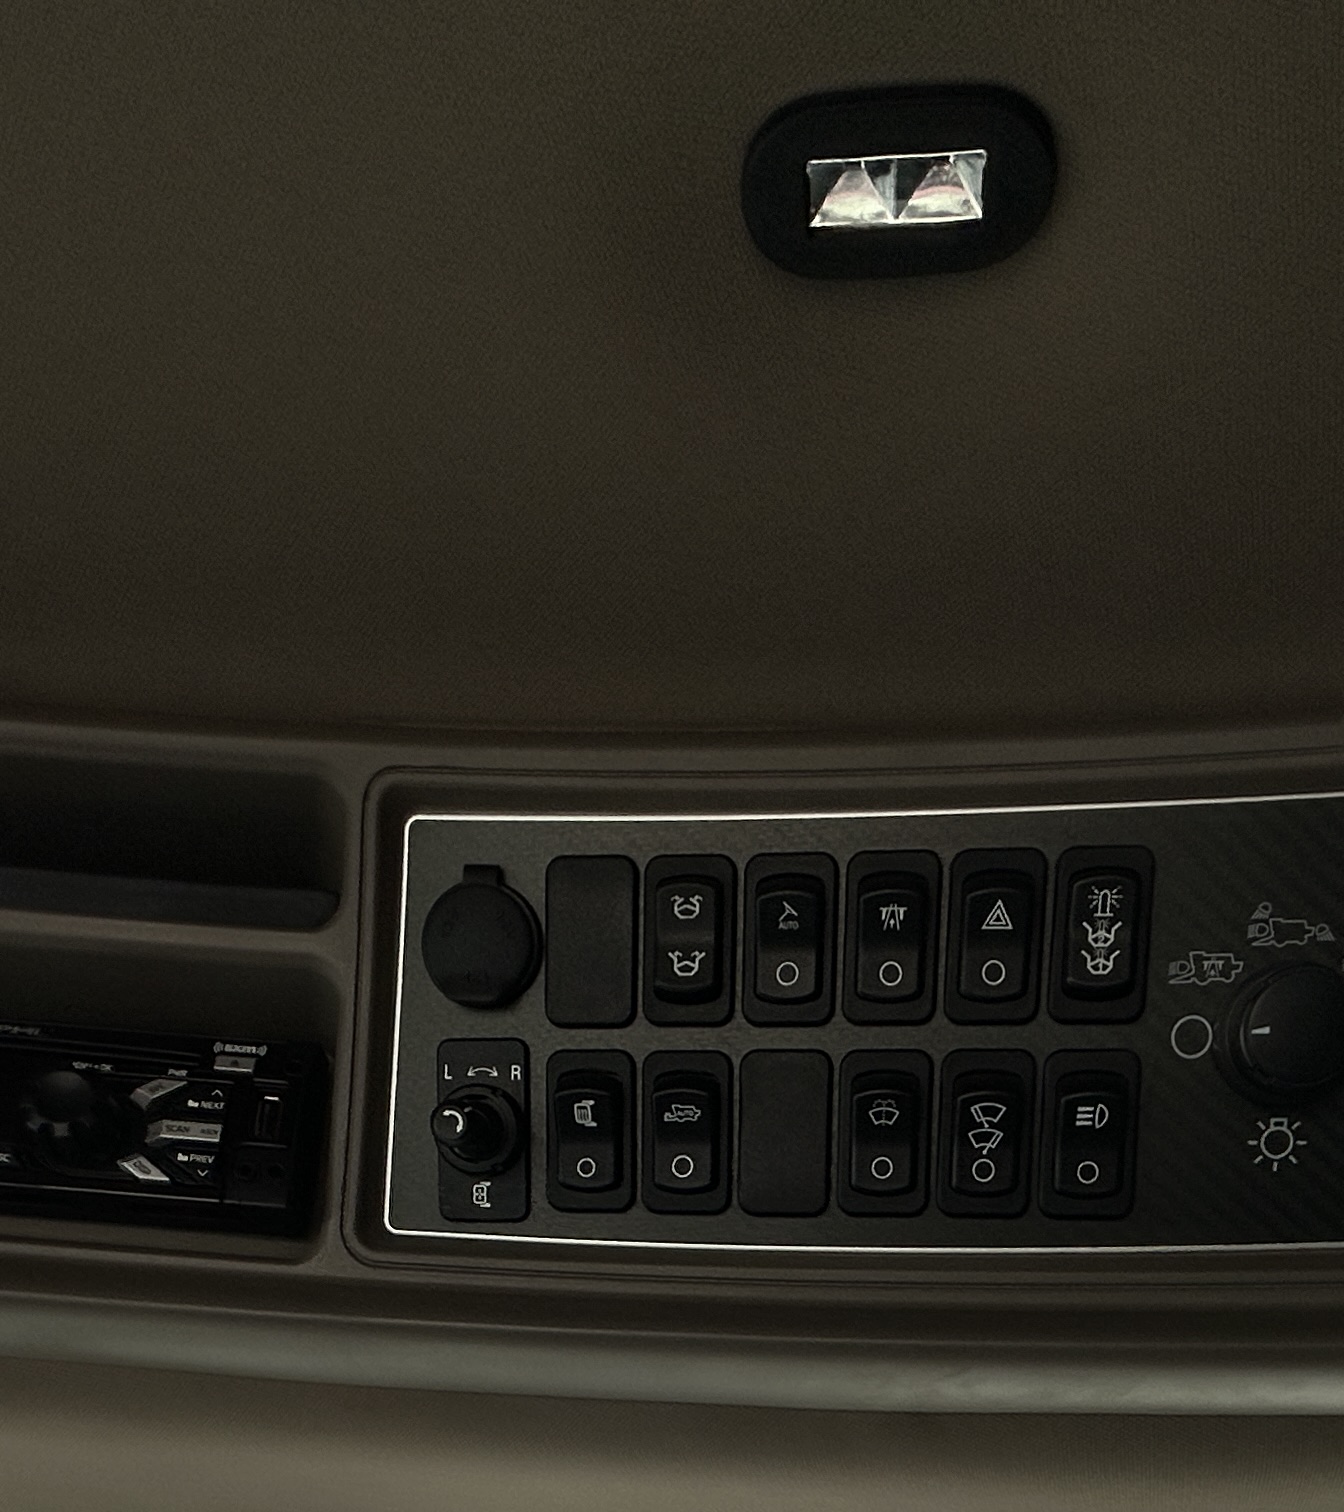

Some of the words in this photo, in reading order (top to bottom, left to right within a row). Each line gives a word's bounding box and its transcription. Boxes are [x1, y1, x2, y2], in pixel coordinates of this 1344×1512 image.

[443, 1064, 453, 1081] L
[510, 1065, 522, 1081] R
[200, 1101, 225, 1109] NEXT
[165, 1124, 190, 1133] SCAN
[189, 1154, 215, 1164] PREV
